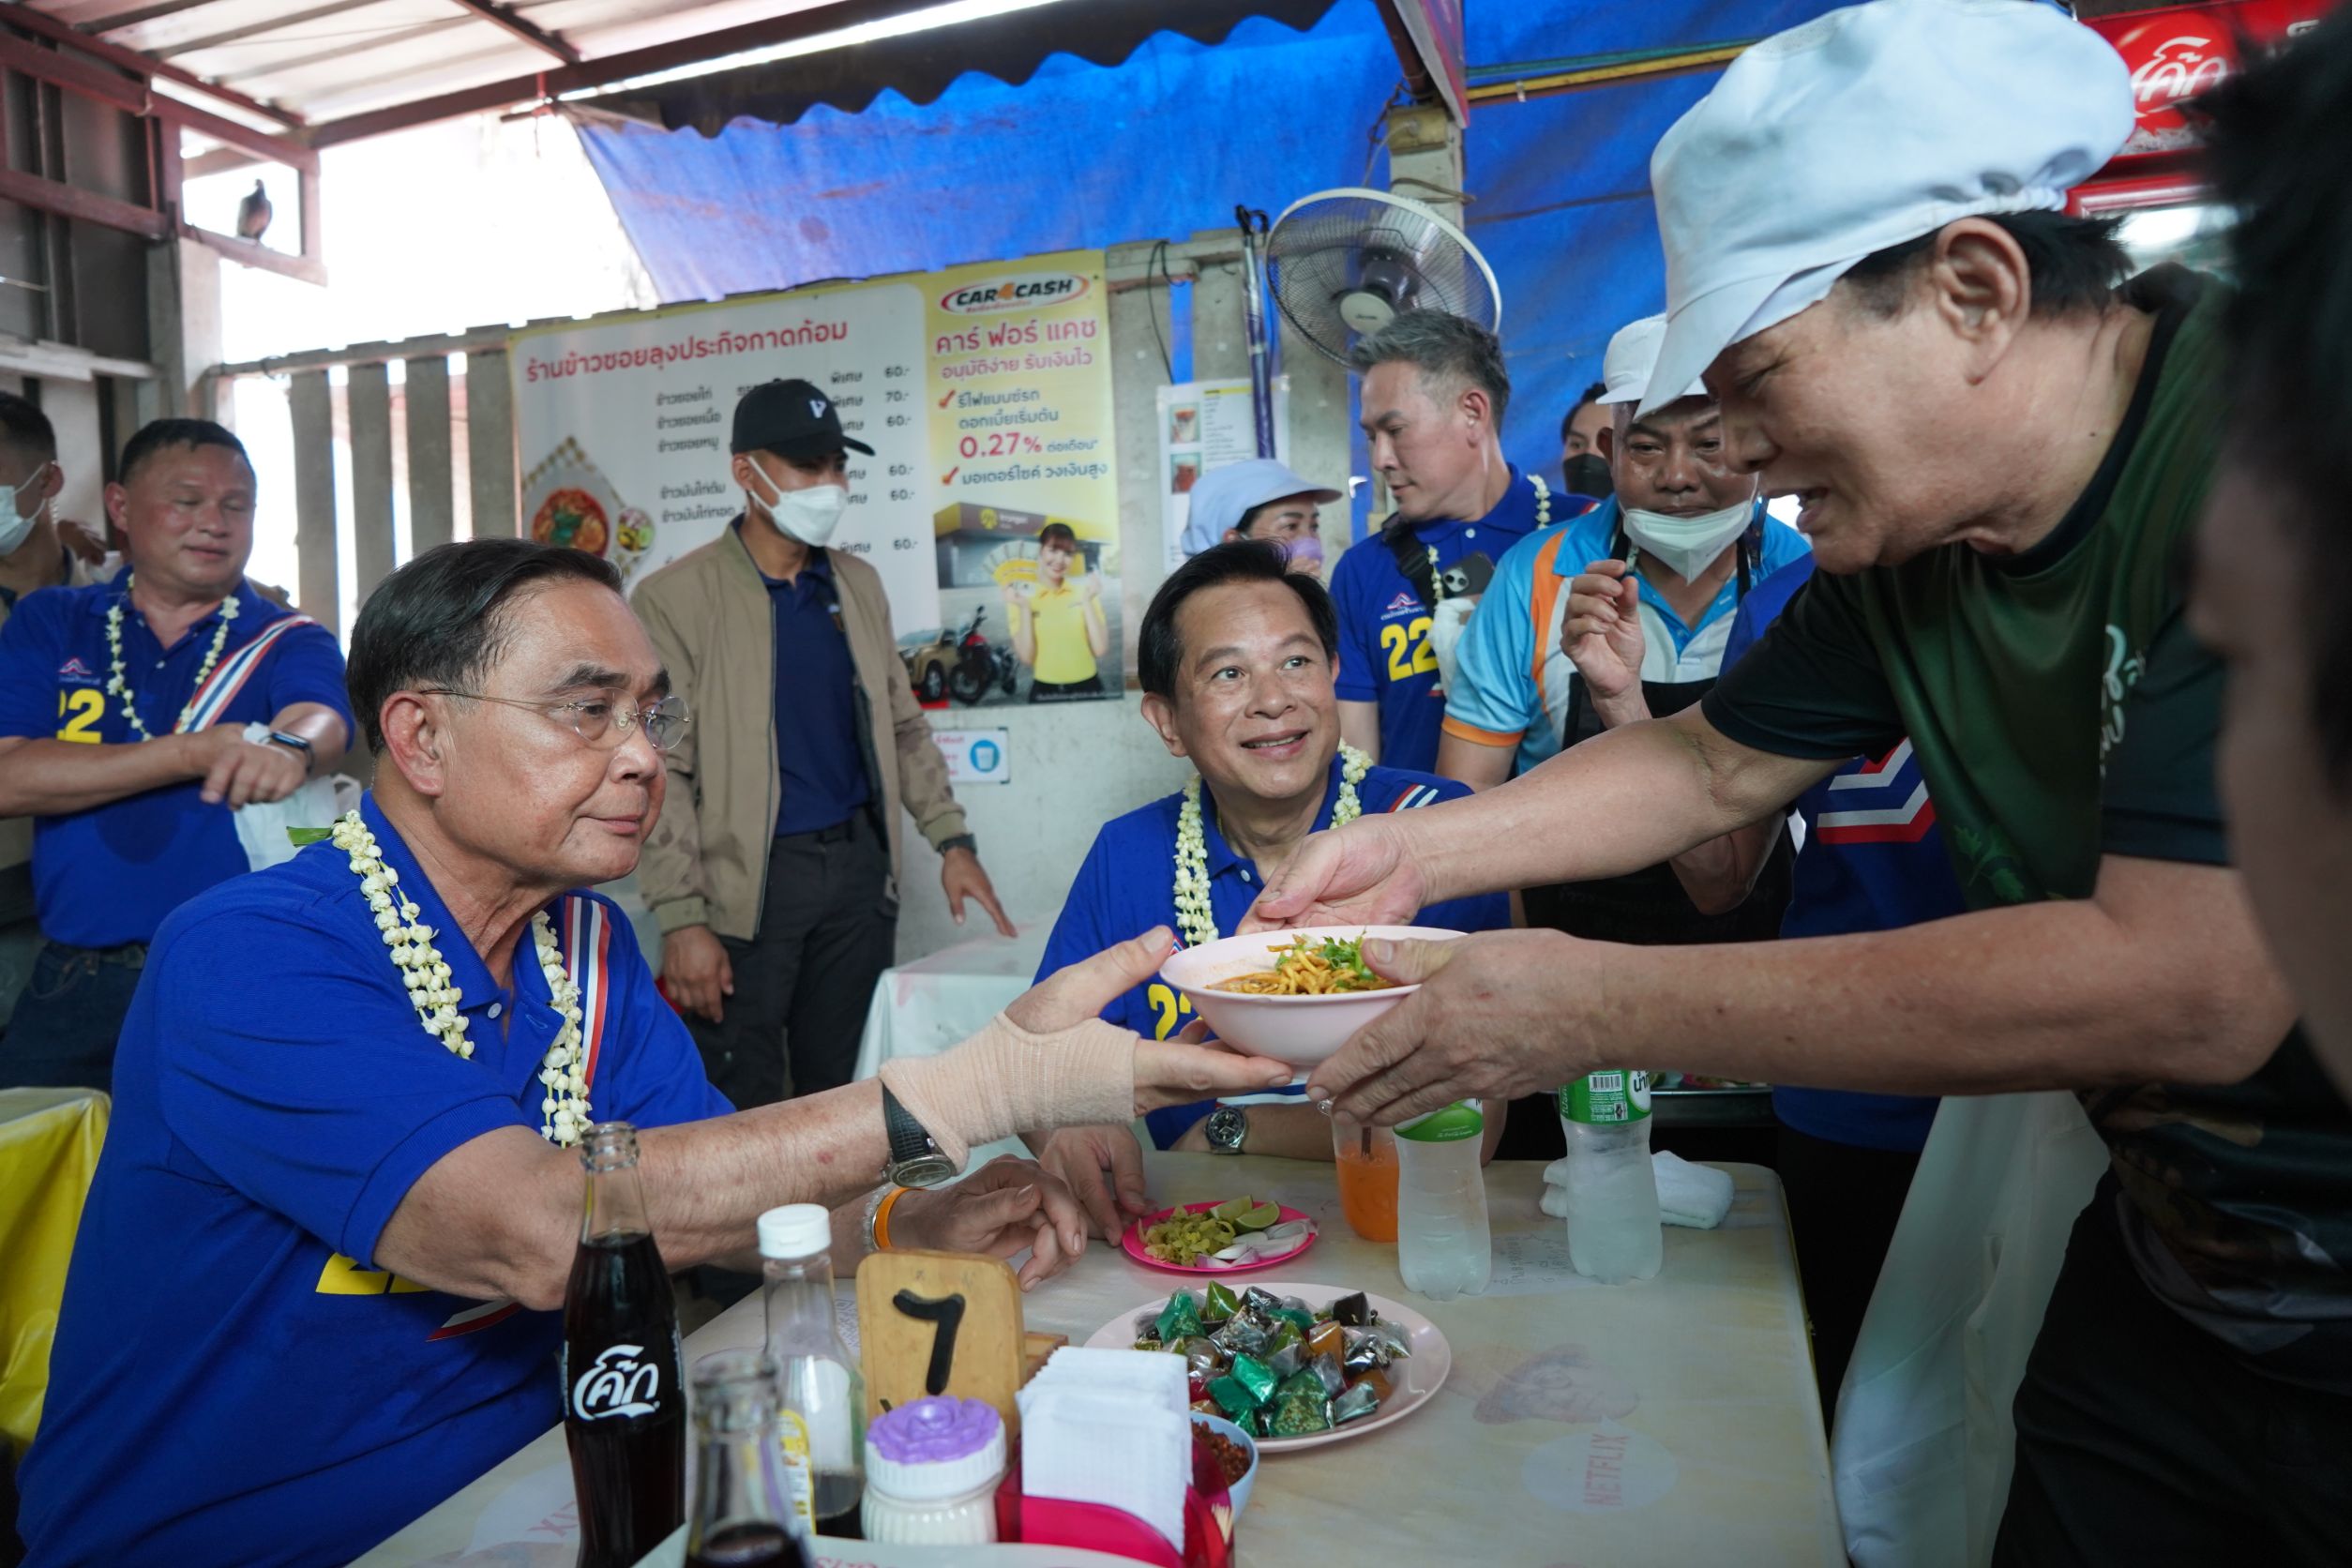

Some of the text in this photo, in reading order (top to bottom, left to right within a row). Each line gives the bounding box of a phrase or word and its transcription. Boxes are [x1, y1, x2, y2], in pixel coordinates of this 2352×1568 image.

[956, 279, 1074, 307] CAR4CASH
[526, 319, 849, 382] ร้านข้าวซอยลุงประกิจกาดก้อม
[936, 319, 1096, 354] คาร์ ฟอร์ แคช
[942, 346, 1093, 382] อนุมัติง่าย รับเงินไว
[959, 431, 1043, 459] 0.27%
[1380, 616, 1440, 682] 22
[1148, 983, 1203, 1042] 2
[892, 1288, 967, 1395] 7
